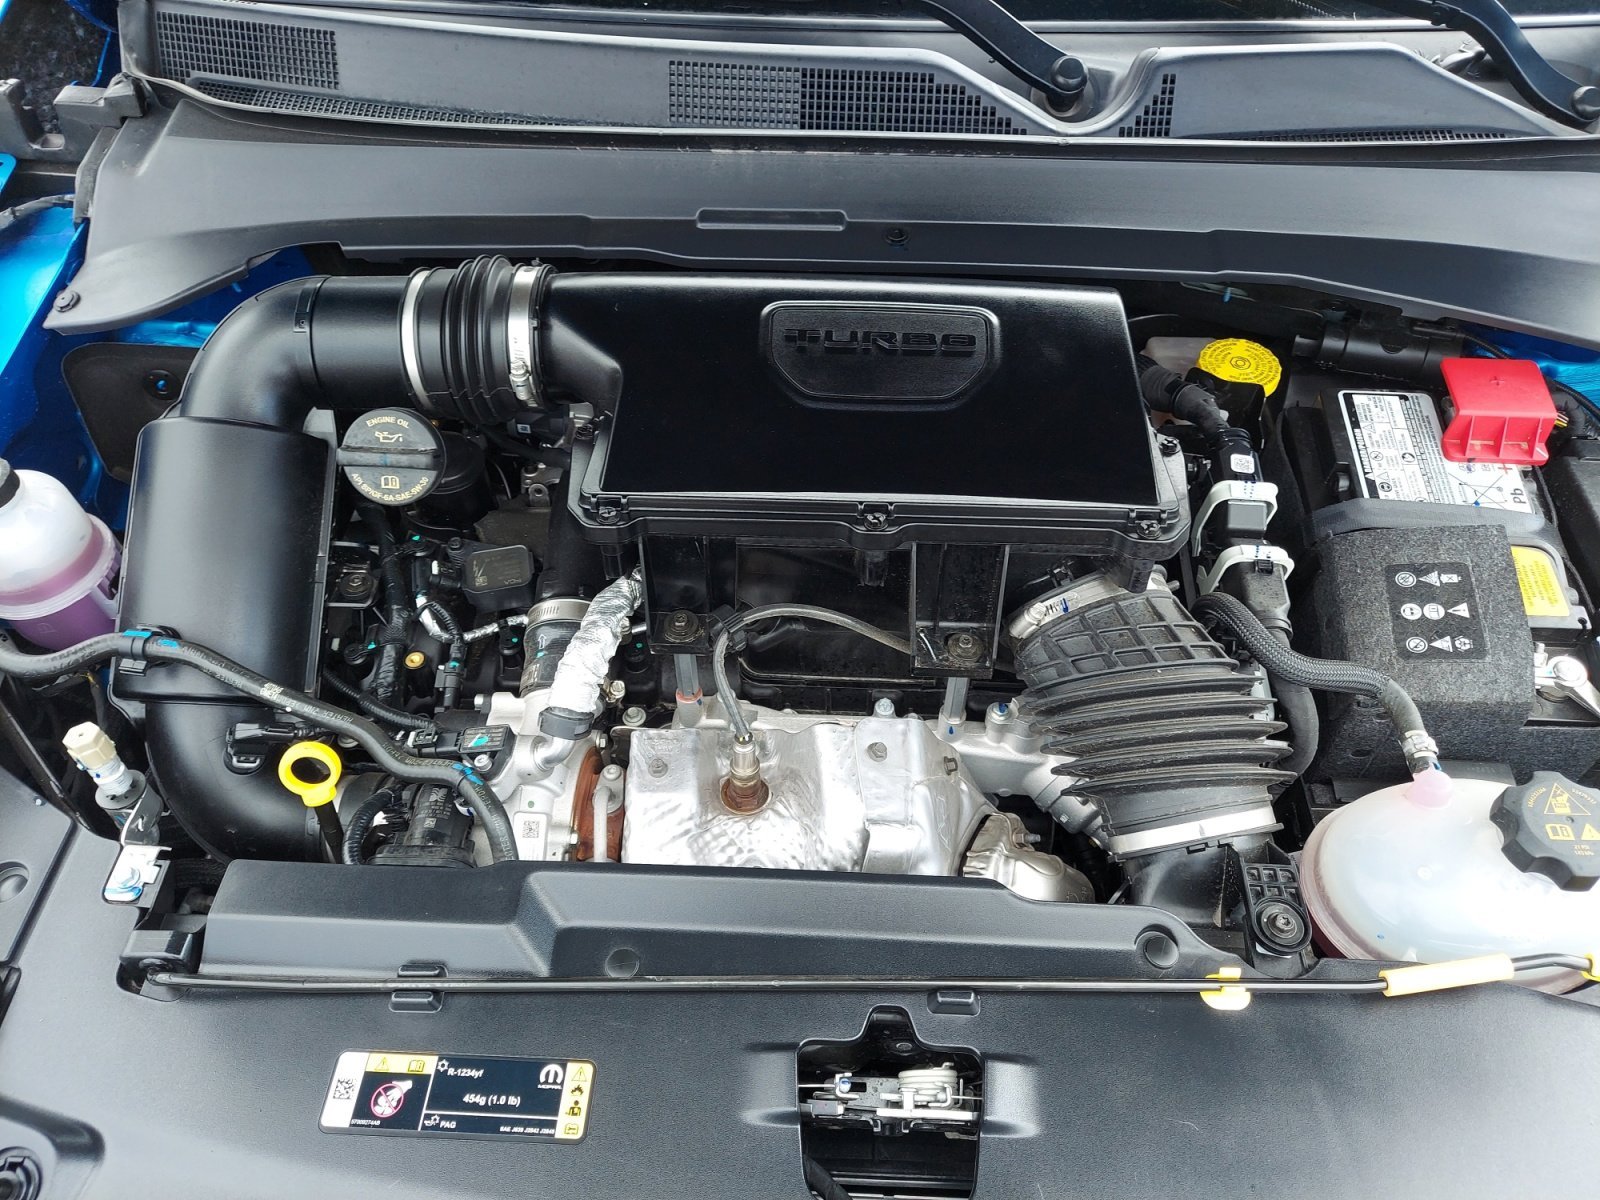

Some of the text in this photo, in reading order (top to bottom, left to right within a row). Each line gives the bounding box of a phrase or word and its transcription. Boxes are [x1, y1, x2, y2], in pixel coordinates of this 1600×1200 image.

[784, 328, 977, 353] TURBO
[366, 416, 410, 429] ENGINE OIL
[1510, 487, 1527, 505] Pb
[447, 1067, 484, 1078] R-1234yf
[462, 1093, 521, 1107] 454g (1.0 lb)
[439, 1120, 457, 1129] PAG
